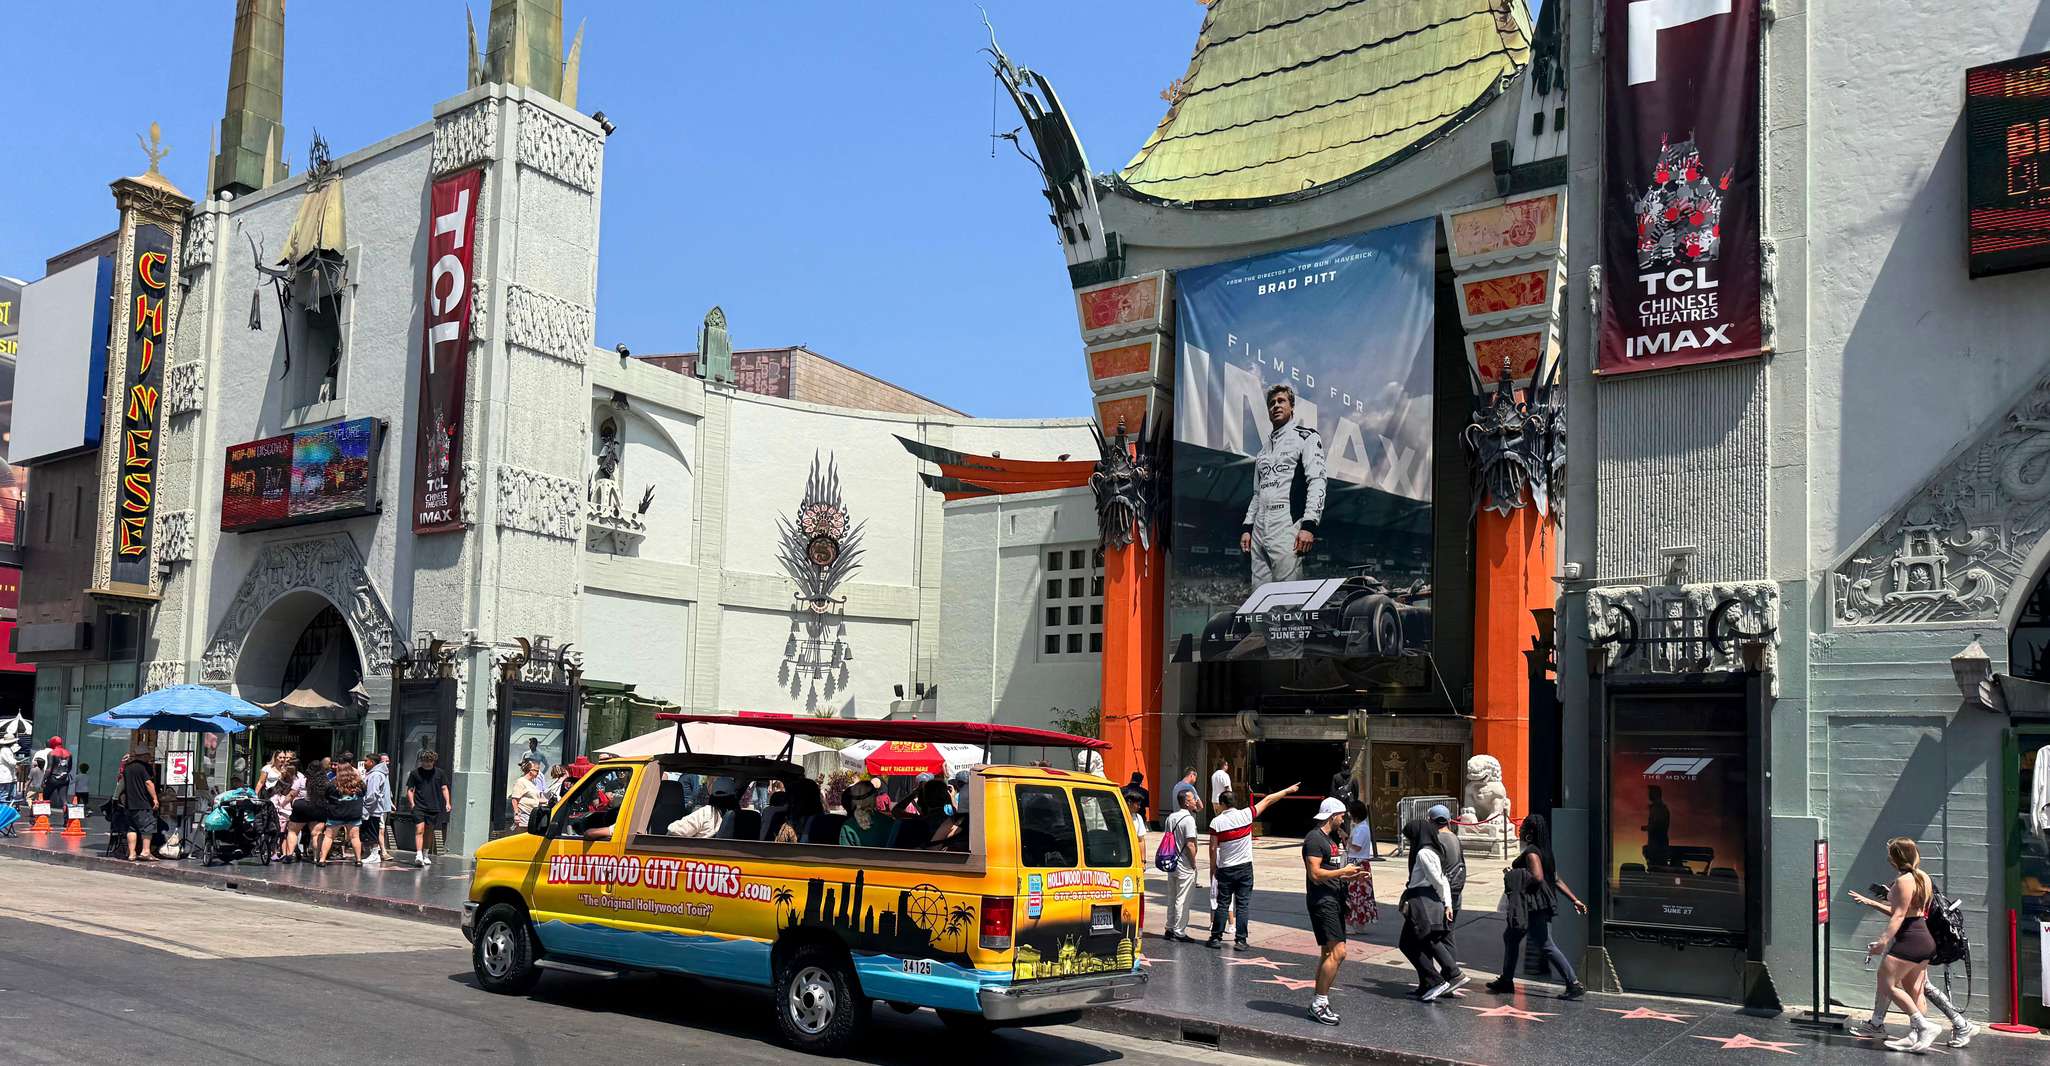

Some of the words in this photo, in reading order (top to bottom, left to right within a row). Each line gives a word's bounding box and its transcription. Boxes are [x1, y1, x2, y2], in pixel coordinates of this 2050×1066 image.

[1226, 278, 1243, 286] FROM
[1257, 269, 1286, 280] DIRECTOR
[1298, 263, 1311, 271] TOP
[1334, 251, 1373, 264] MAVERICK
[428, 188, 469, 374] TCL
[1258, 278, 1297, 296] BRAD
[1304, 270, 1337, 287] PITT
[1639, 267, 1719, 295] TCL
[1638, 292, 1719, 315] CHINESE
[1638, 306, 1719, 327] THEATRES
[1228, 333, 1316, 388] FILMED
[119, 251, 167, 556] CHINESE
[1330, 386, 1364, 413] FOR
[426, 476, 448, 492] TCL
[419, 509, 452, 525] IMAX
[1235, 614, 1263, 623] THE
[1271, 612, 1320, 621] MOVIE
[1270, 631, 1296, 640] JUNE
[1298, 631, 1311, 639] 27
[548, 855, 641, 885] HOLLYWOOD
[644, 858, 681, 888] CITY
[1047, 870, 1081, 888] HOLLYWOOD
[601, 895, 634, 911] Original
[637, 899, 684, 914] Hollywood
[903, 959, 931, 975] 34125
